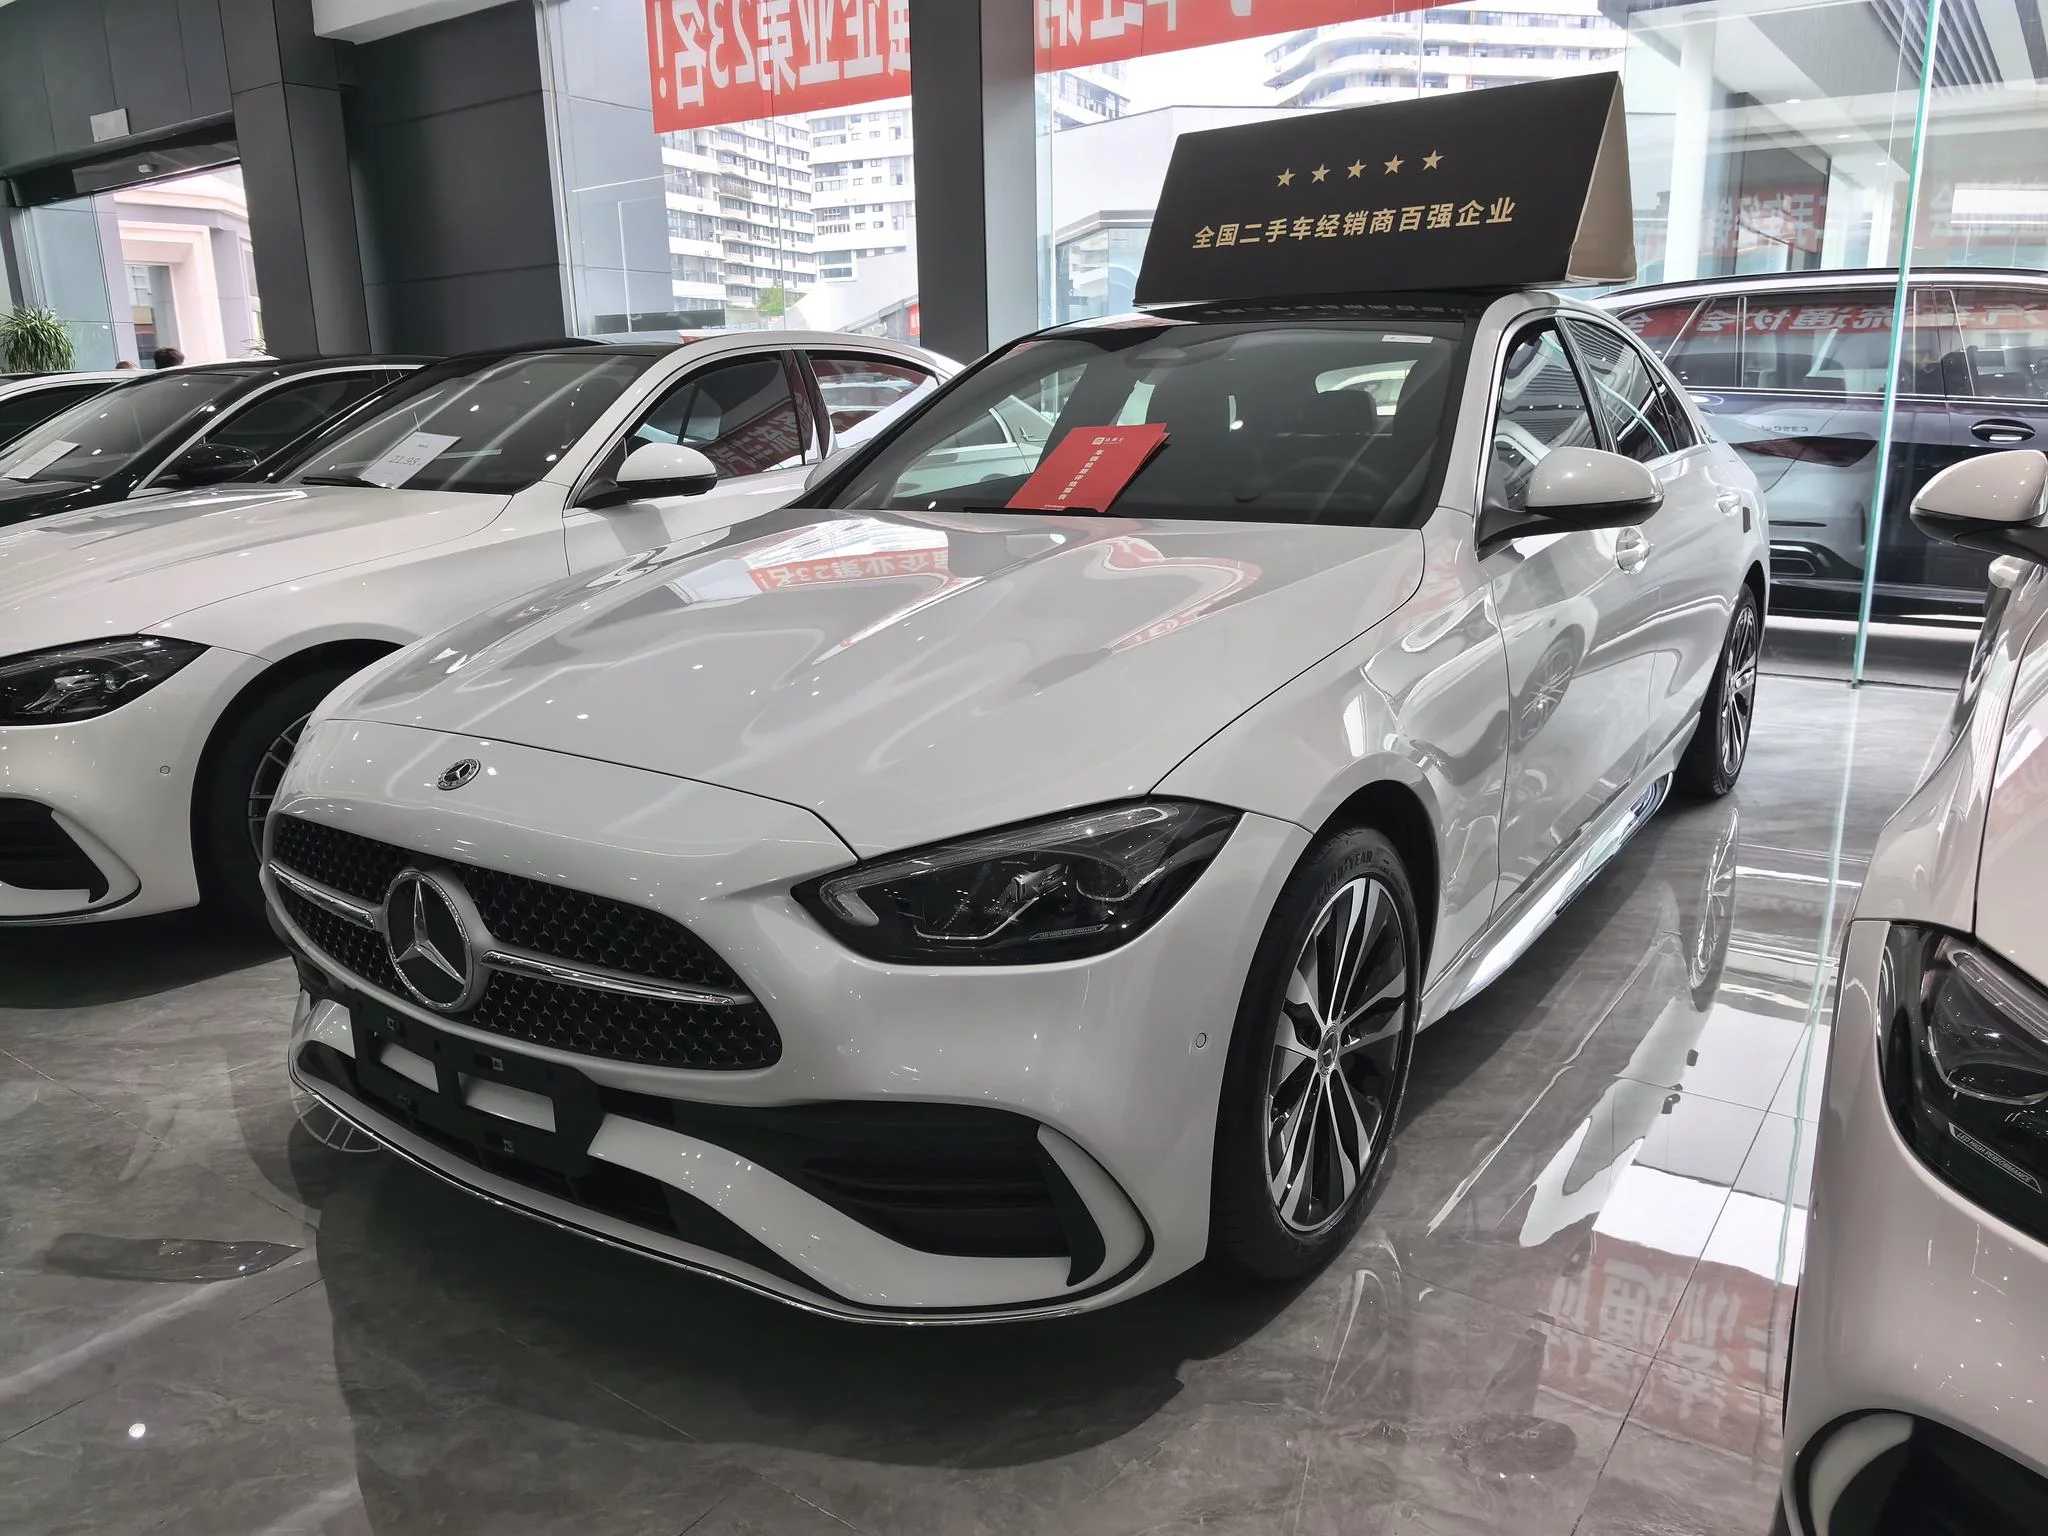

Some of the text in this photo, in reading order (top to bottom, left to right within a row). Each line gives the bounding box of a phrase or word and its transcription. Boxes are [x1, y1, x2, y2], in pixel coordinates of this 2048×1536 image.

[1192, 197, 1516, 249] 全国二手车经销商百强企业
[1957, 1132, 2034, 1184] LED HIGH PERFORMANCE
